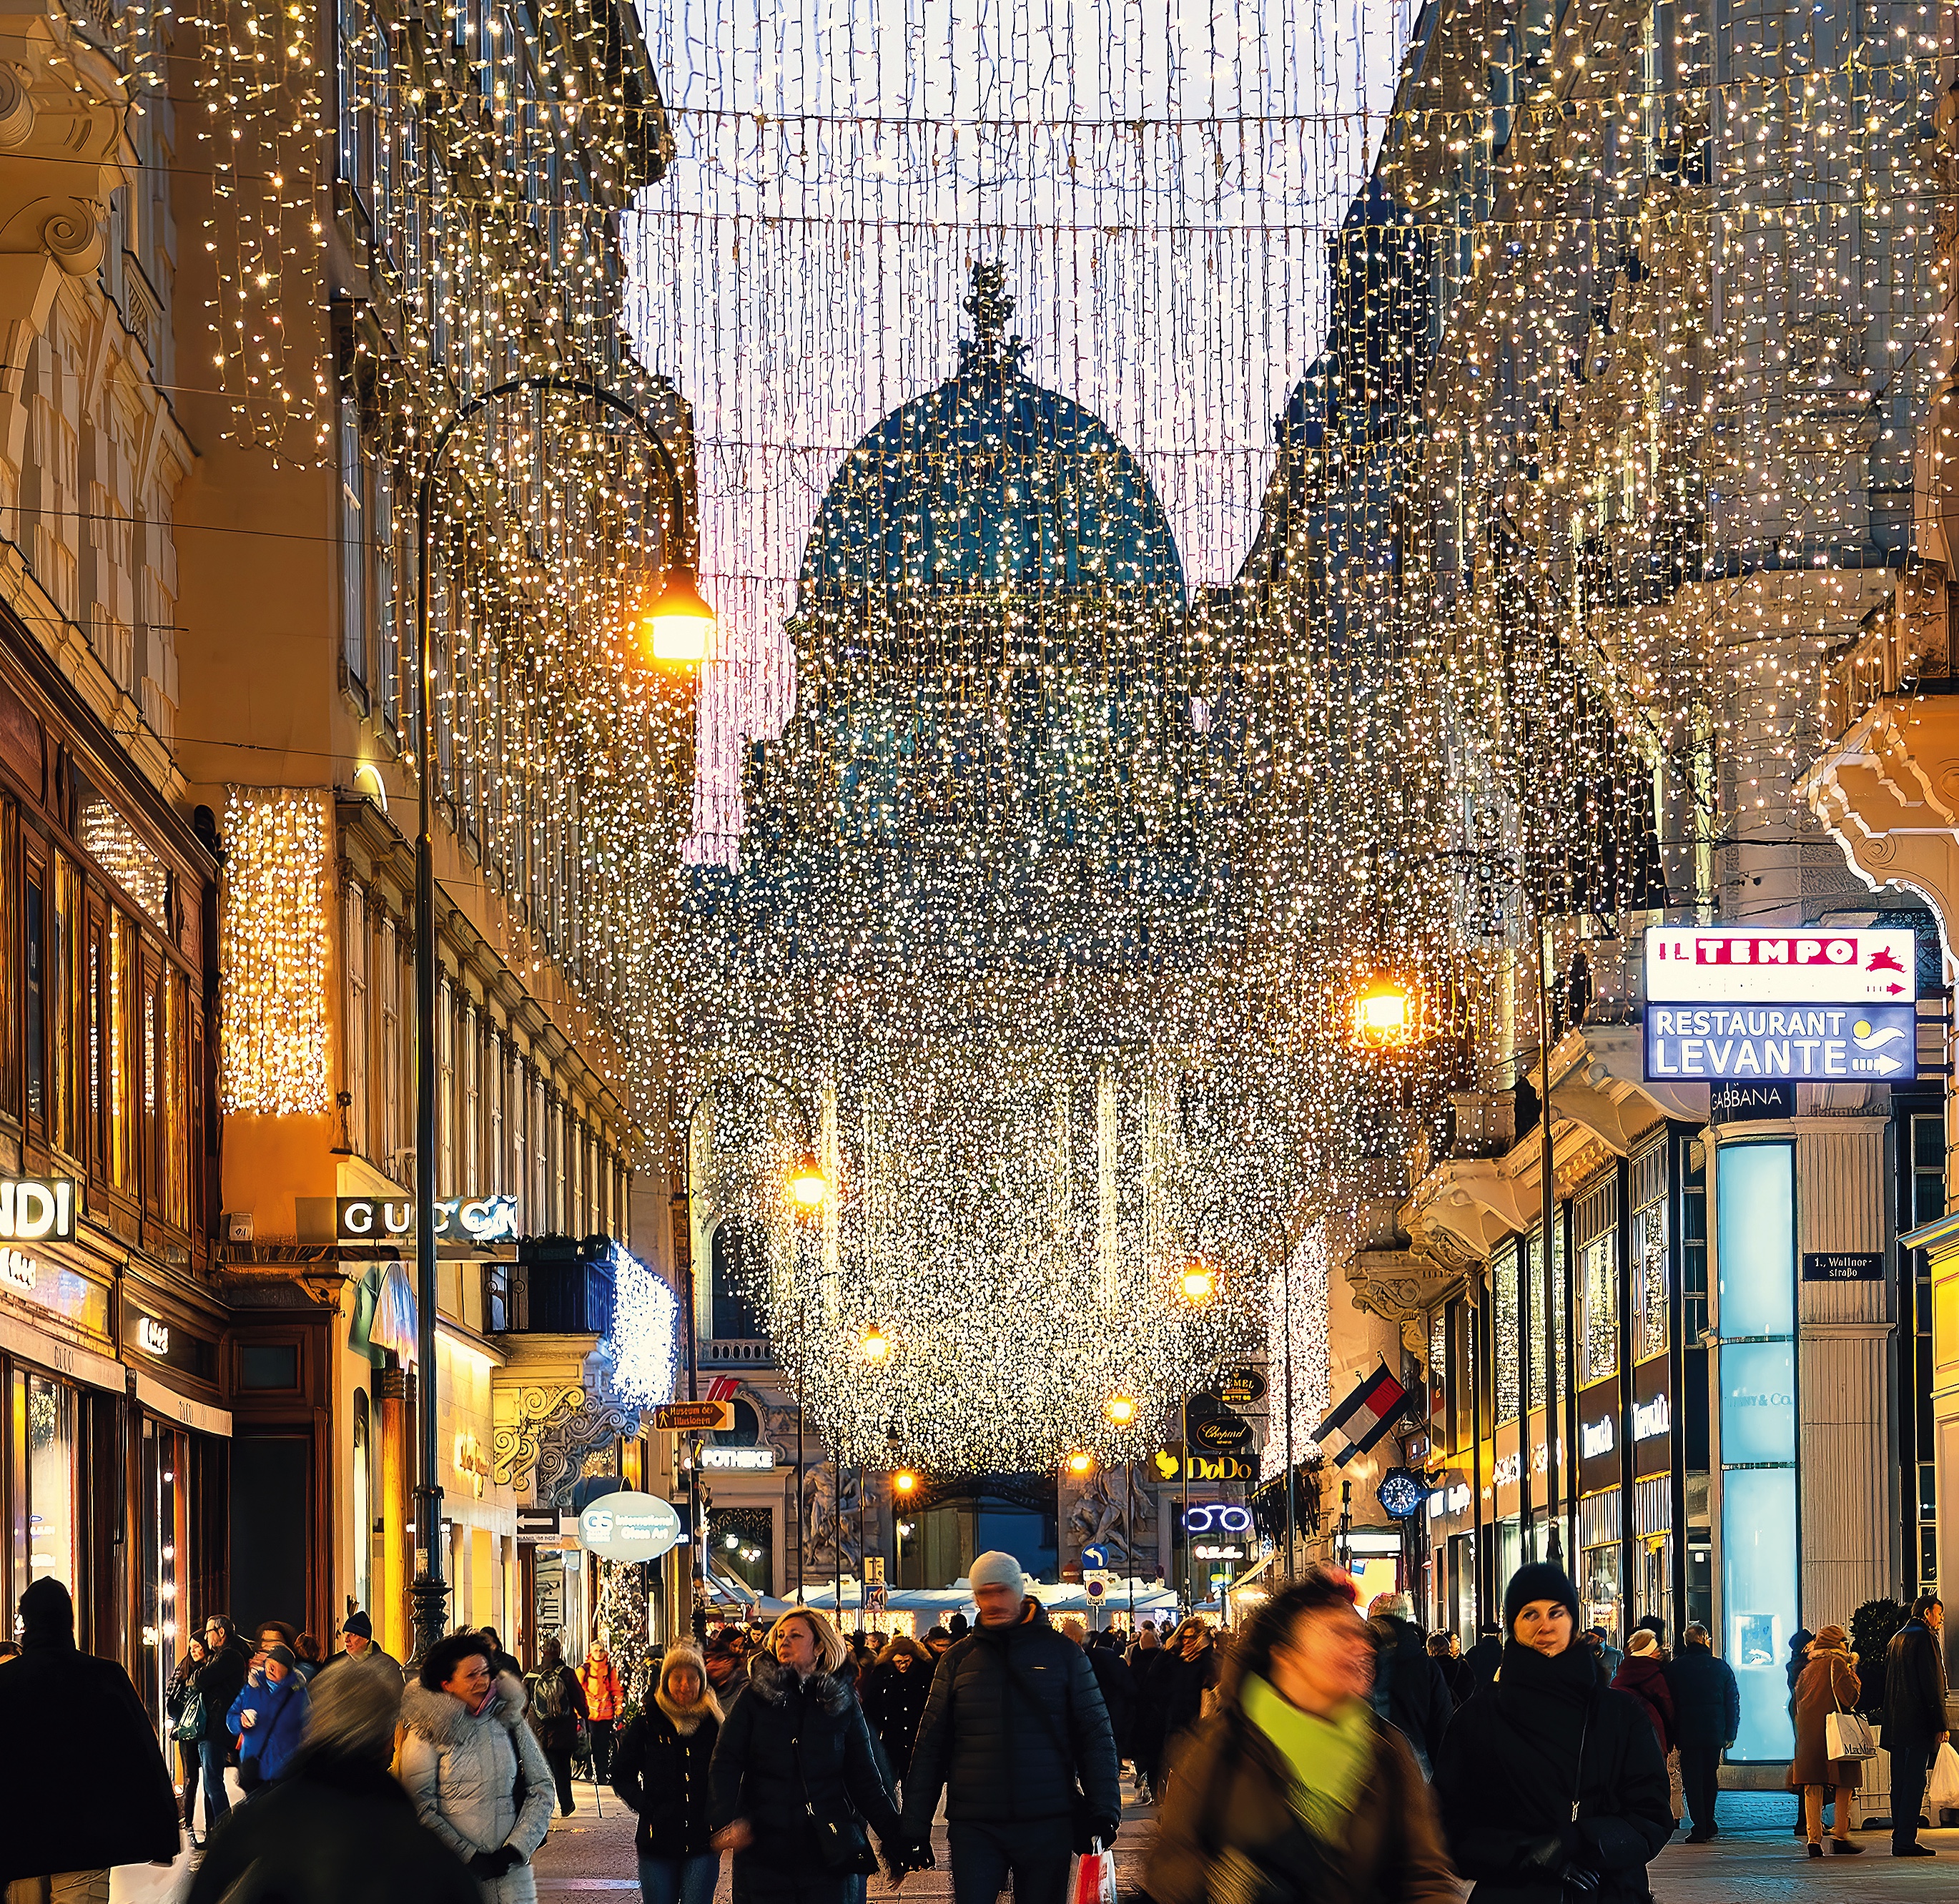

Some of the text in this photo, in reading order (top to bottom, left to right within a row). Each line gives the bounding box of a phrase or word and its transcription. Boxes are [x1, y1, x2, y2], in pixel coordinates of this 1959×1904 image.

[1659, 940, 1853, 964] IL TEMPO
[1657, 1011, 1845, 1037] RESTAURANT
[1656, 1039, 1847, 1075] LEVANTE
[1711, 1087, 1782, 1110] GABBANA
[670, 1406, 714, 1416] Museum der
[673, 1416, 711, 1425] Illusionen
[1202, 1425, 1247, 1440] Chopard
[684, 1449, 774, 1468] POTHEKE
[1187, 1456, 1252, 1480] DoDo
